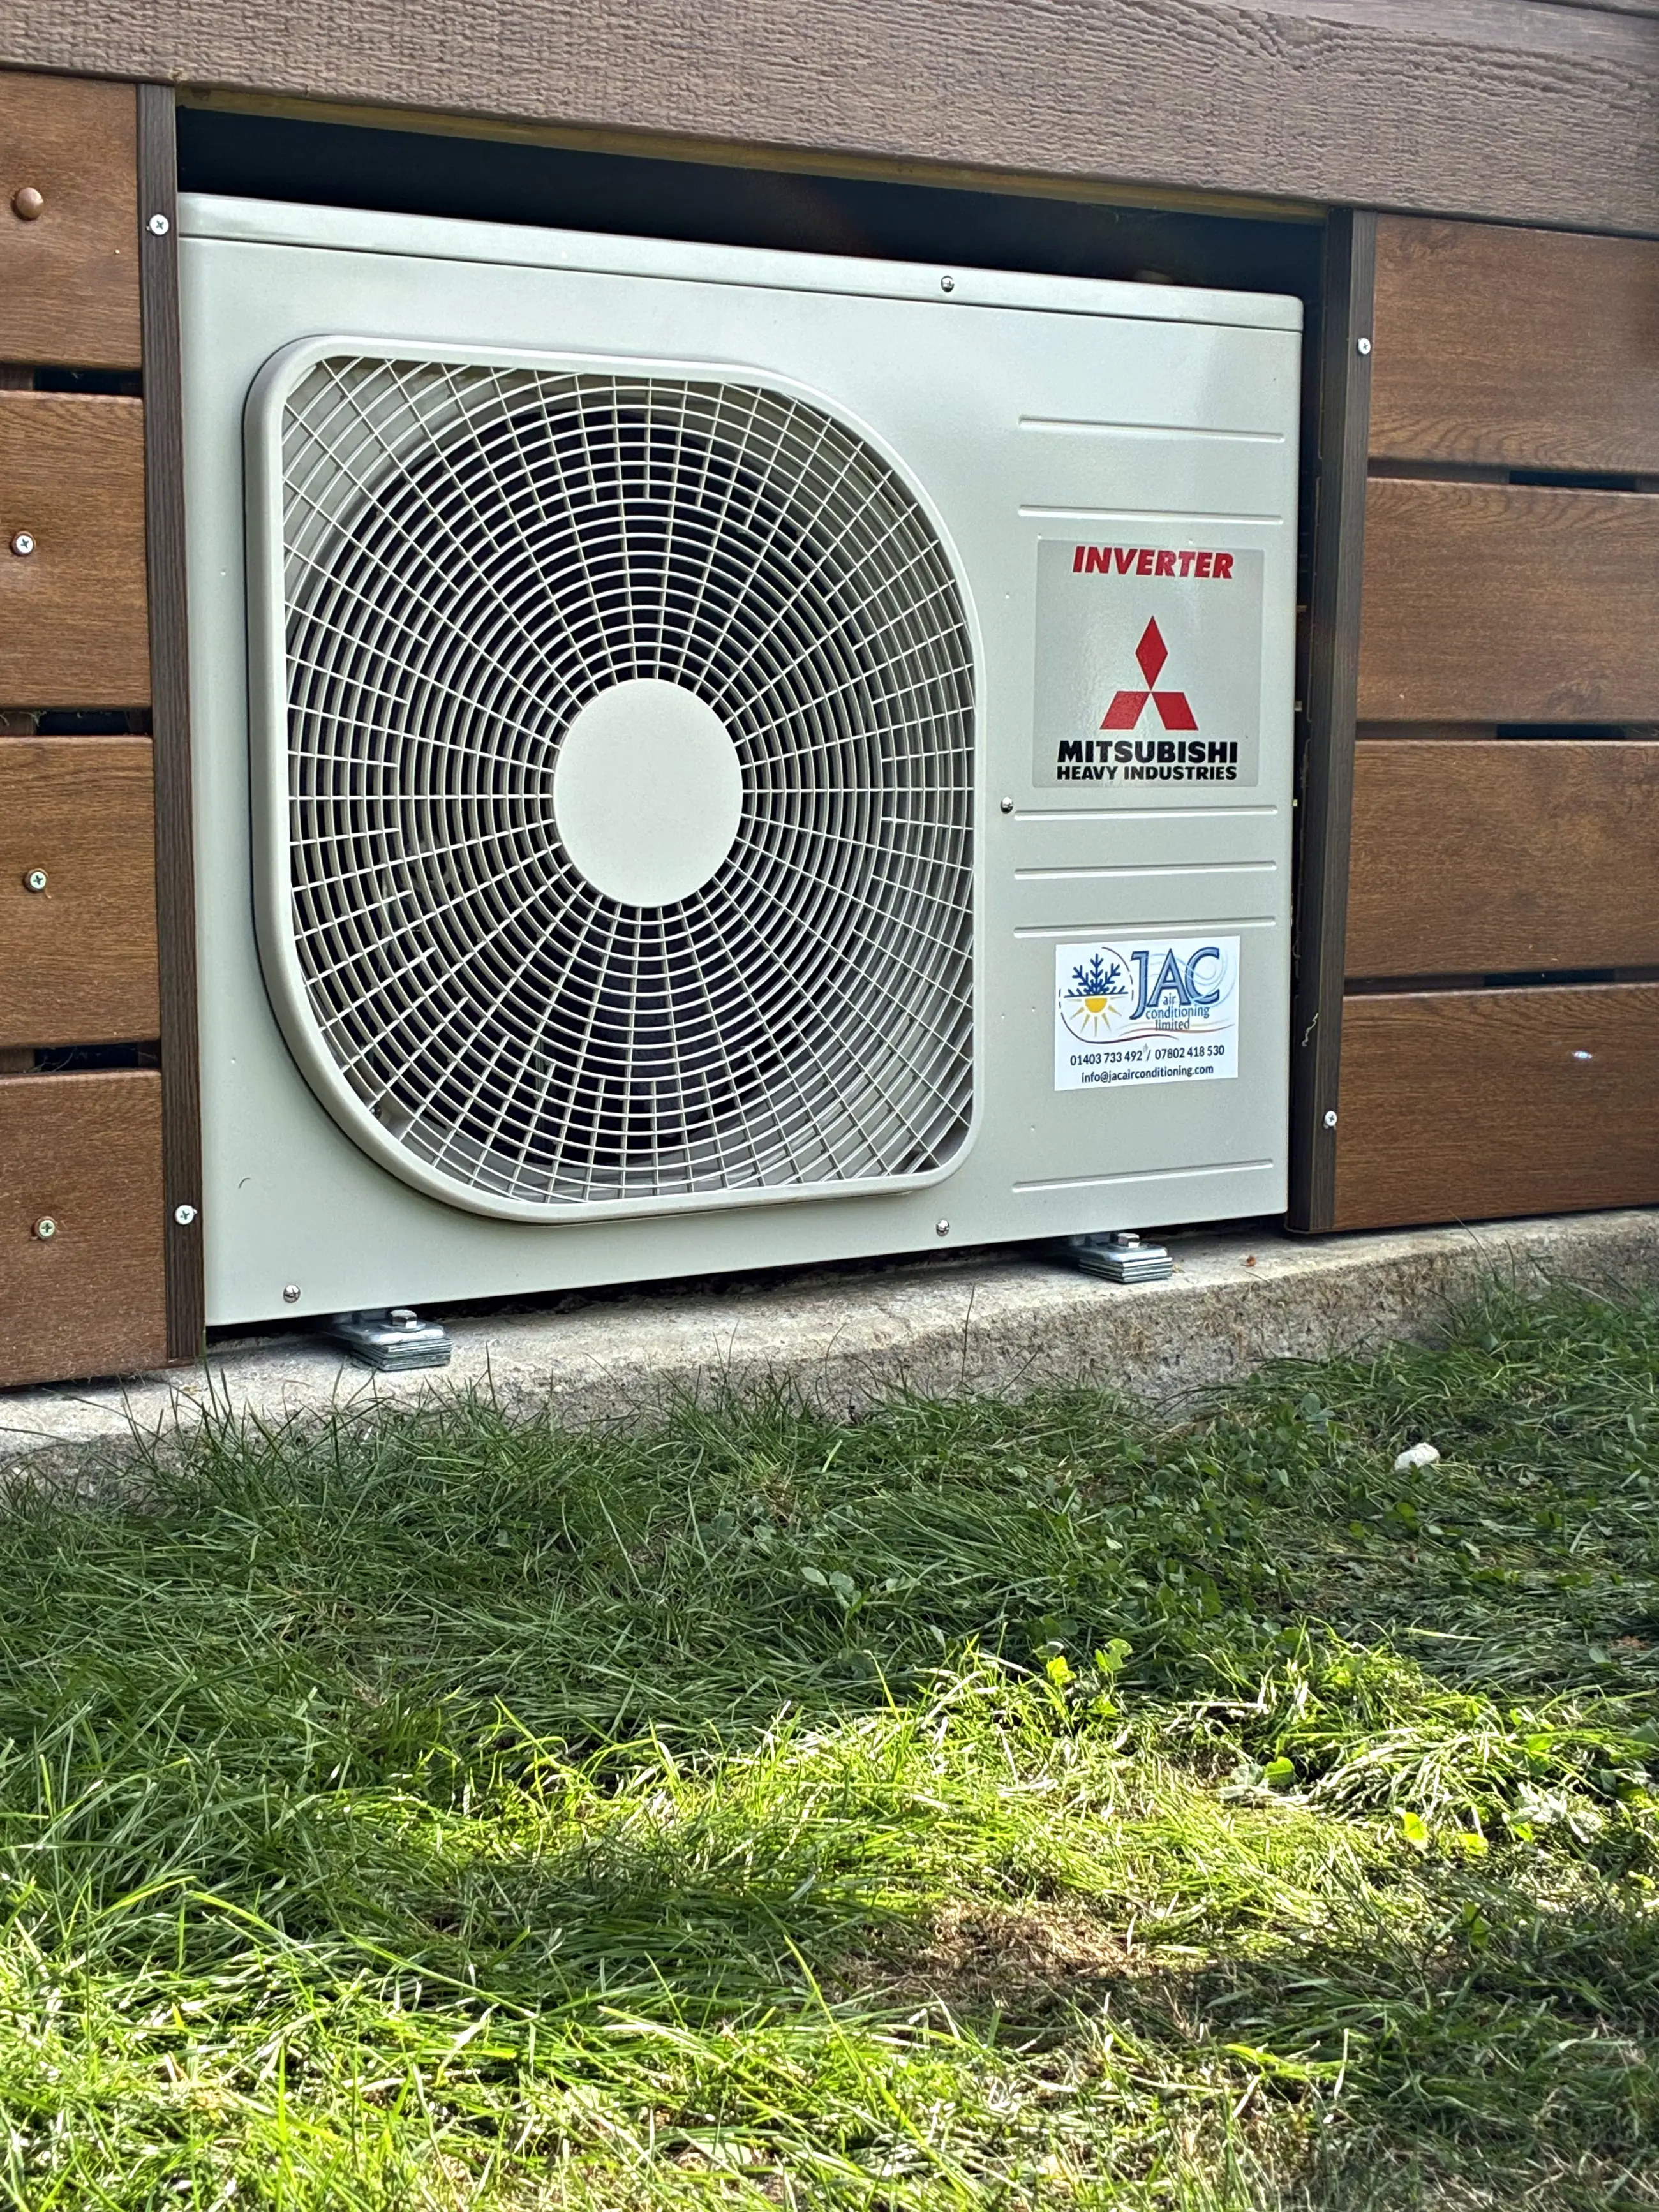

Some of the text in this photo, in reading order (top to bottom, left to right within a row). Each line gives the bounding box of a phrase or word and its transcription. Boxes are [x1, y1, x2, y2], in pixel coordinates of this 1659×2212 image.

[1073, 546, 1234, 579] INVERTER
[1057, 740, 1238, 763] MITSUBISHI
[1057, 766, 1237, 780] HEAVY INDUSTRIES
[1129, 947, 1220, 1020] JAC
[1163, 993, 1176, 1006] air
[1145, 1005, 1210, 1019] conditioning
[1155, 1017, 1190, 1031] limited
[1070, 1053, 1101, 1065] 01403
[1103, 1052, 1122, 1064] 733
[1124, 1050, 1143, 1062] 492
[1155, 1048, 1185, 1060] 07802
[1187, 1046, 1205, 1057] 418
[1207, 1045, 1225, 1057] 530
[1082, 1065, 1214, 1083] info@jacairconditioning.com
